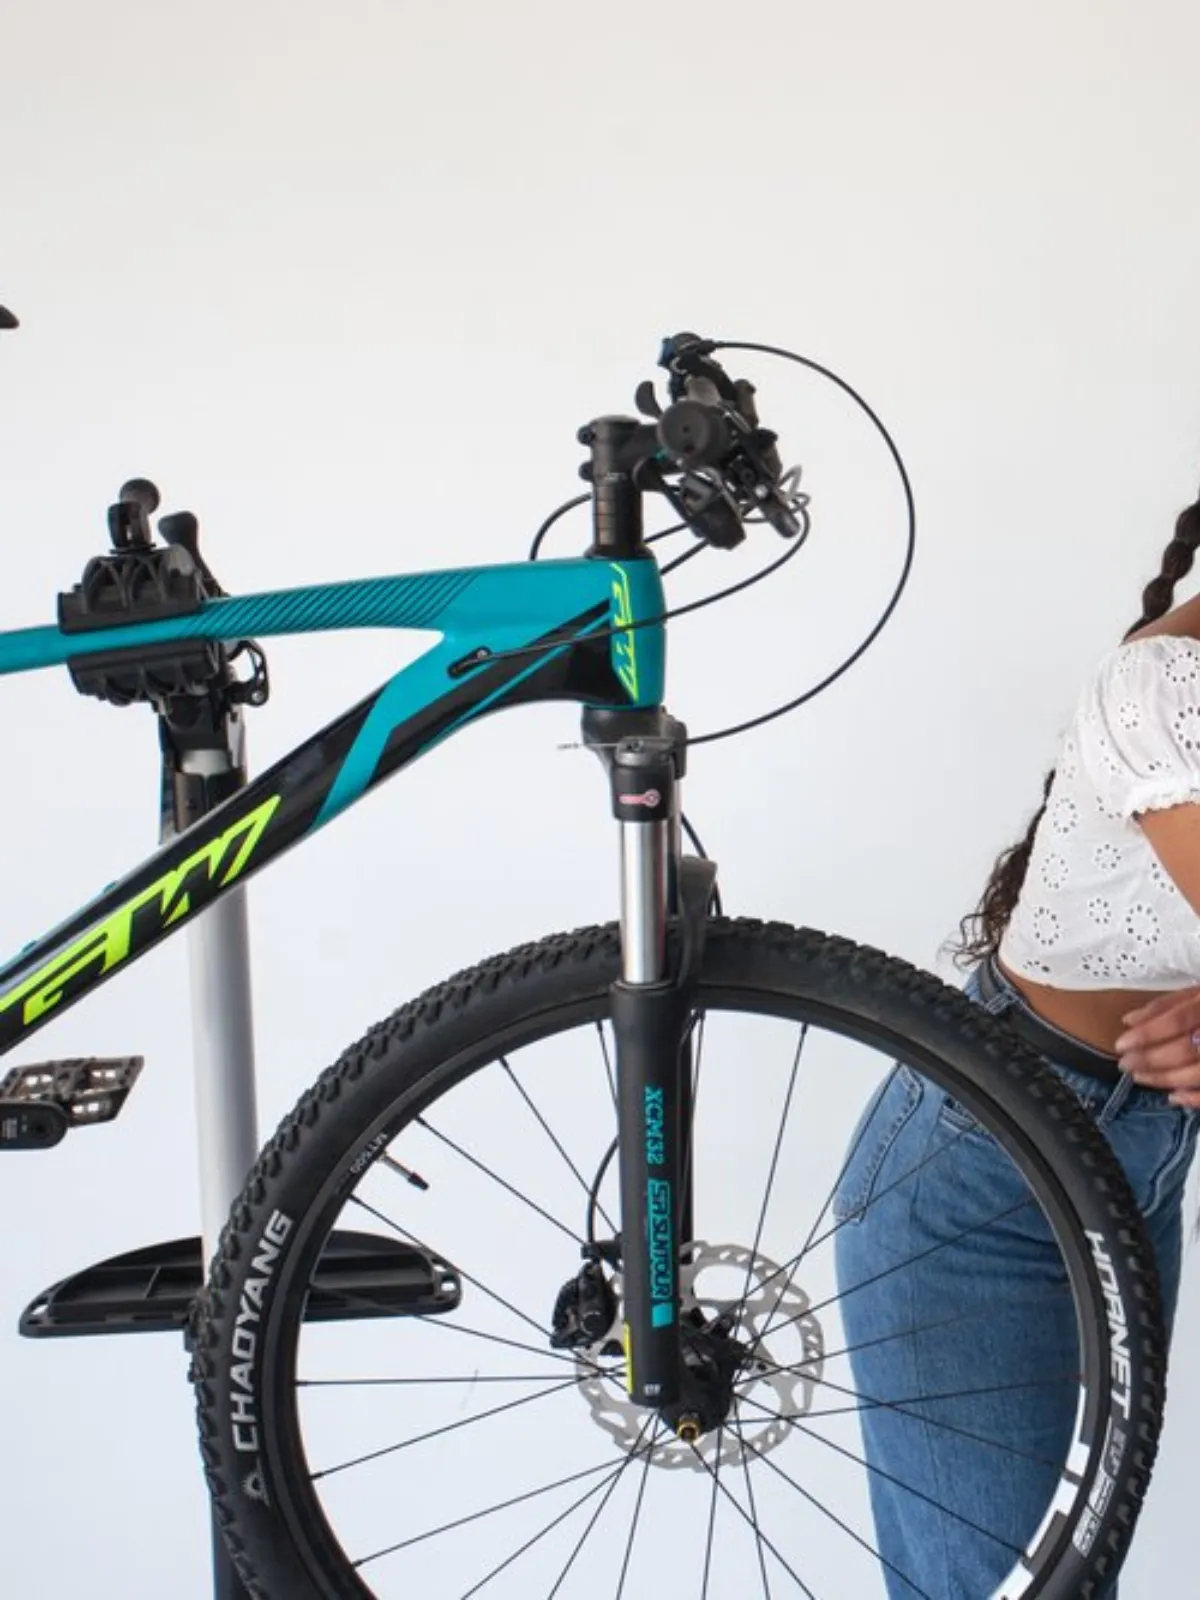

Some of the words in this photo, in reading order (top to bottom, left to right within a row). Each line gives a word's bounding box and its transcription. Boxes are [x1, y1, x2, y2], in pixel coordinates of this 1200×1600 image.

[230, 1208, 293, 1452] CHAOYANG
[652, 1215, 672, 1298] SUNTOUR
[1085, 1229, 1131, 1420] HORNET
